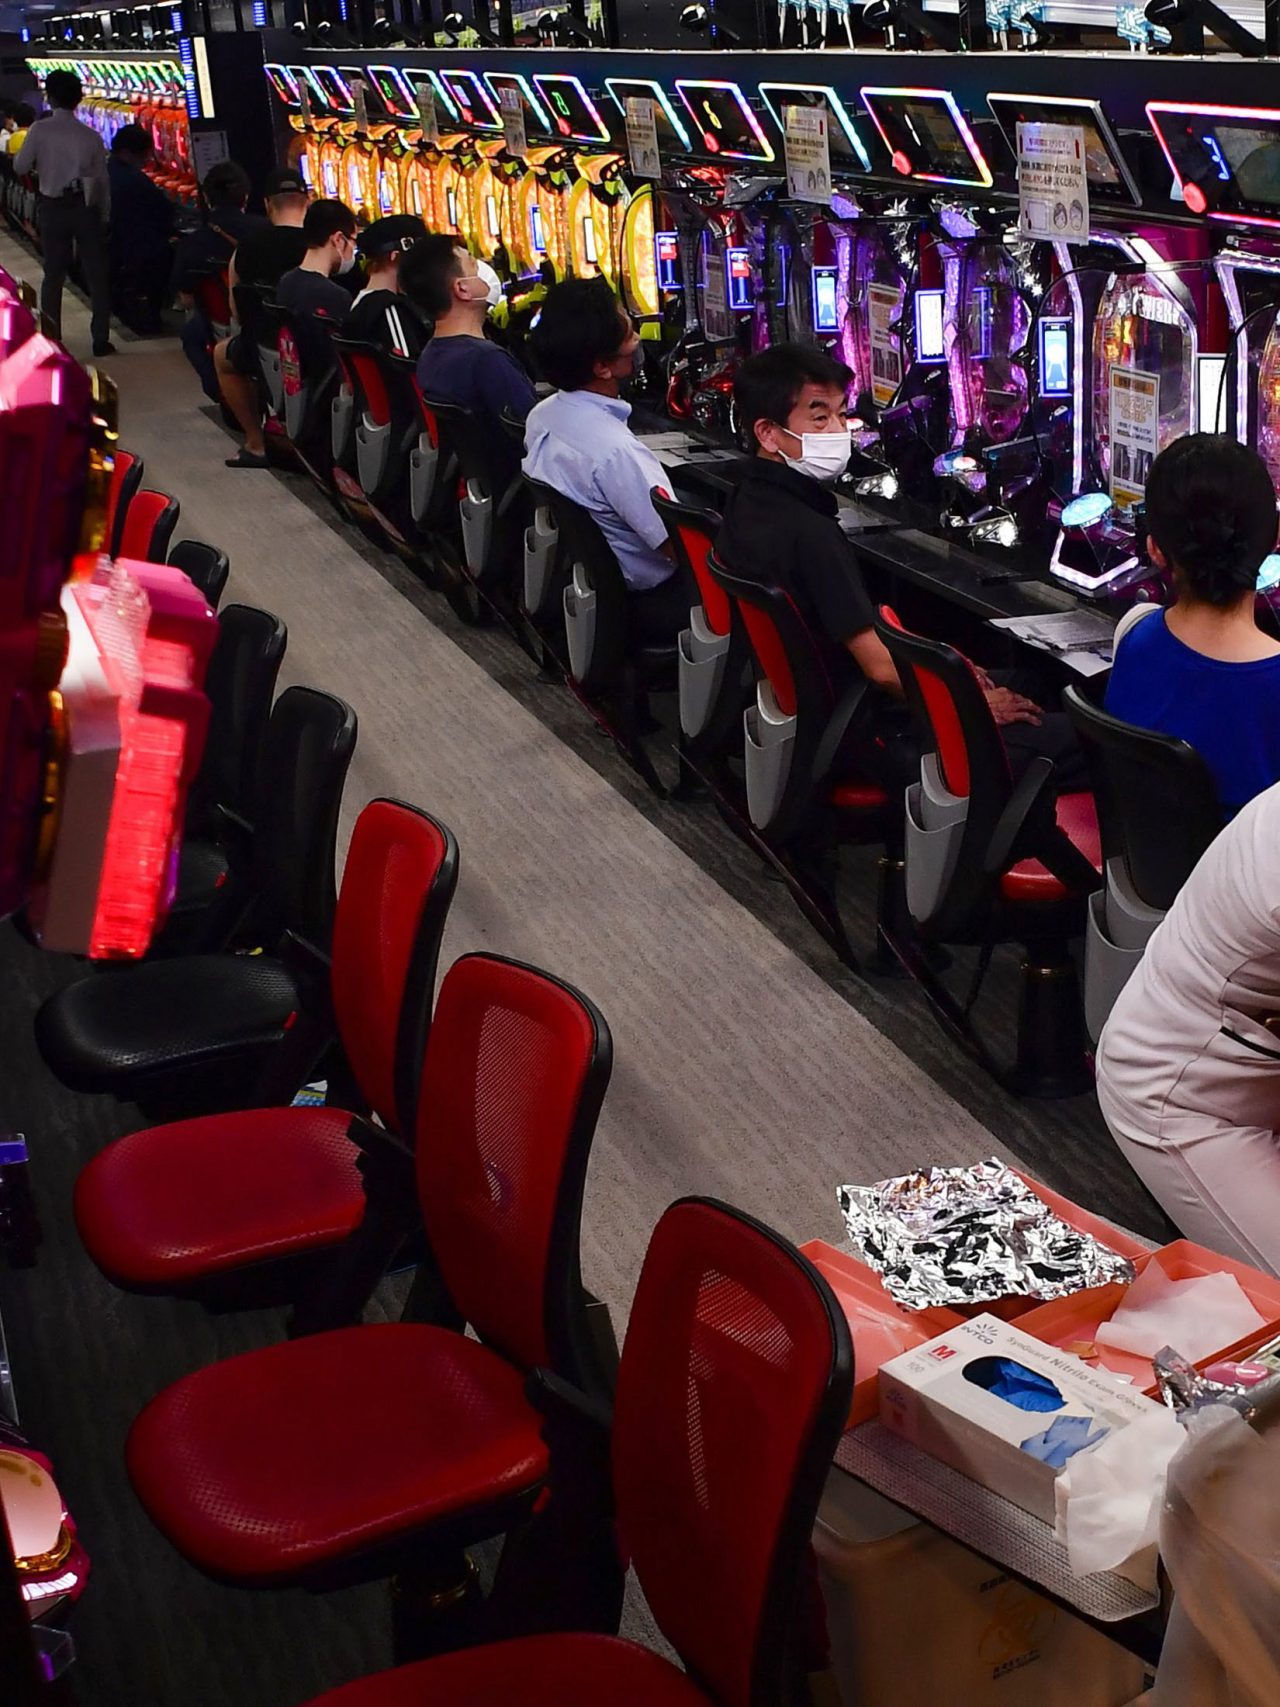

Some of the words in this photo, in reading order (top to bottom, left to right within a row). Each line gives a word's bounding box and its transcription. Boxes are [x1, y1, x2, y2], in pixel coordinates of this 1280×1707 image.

[960, 1324, 995, 1346] INTCO
[931, 1344, 957, 1361] M
[1005, 1335, 1051, 1362] SynGuard
[1050, 1356, 1089, 1383] Nitrile
[1088, 1377, 1116, 1398] Exam
